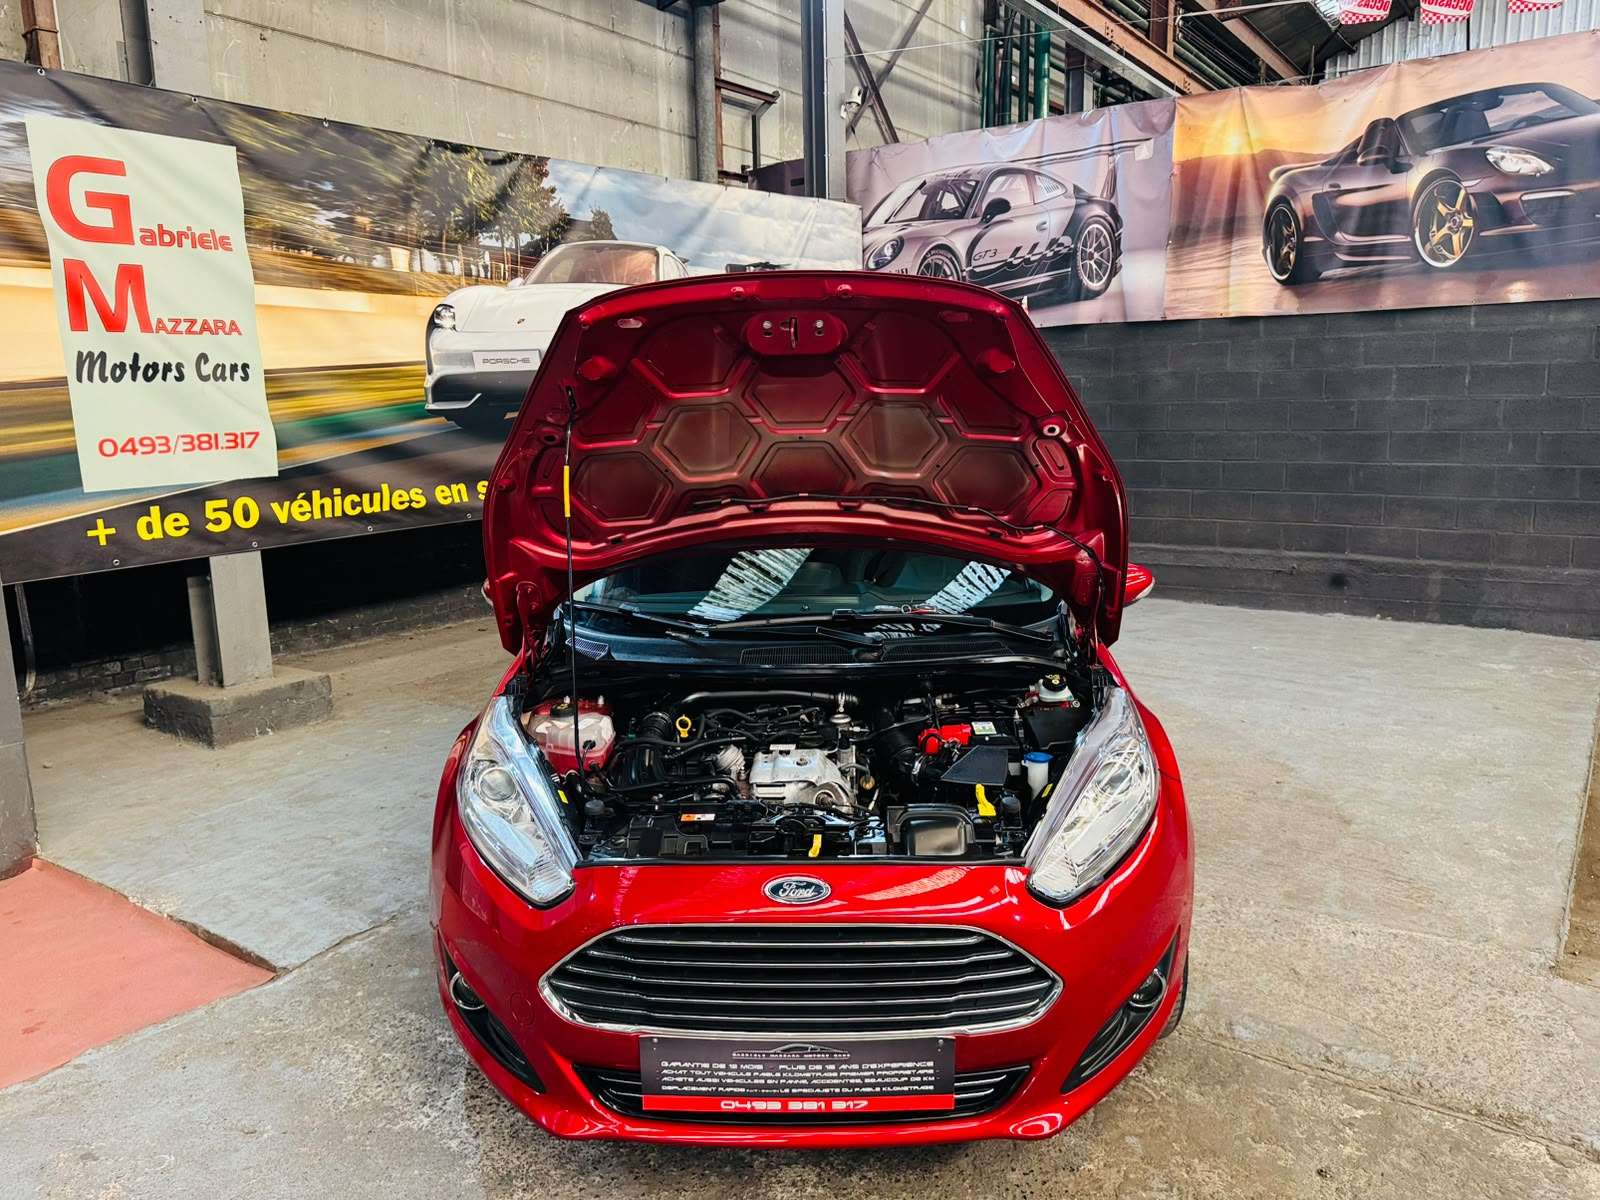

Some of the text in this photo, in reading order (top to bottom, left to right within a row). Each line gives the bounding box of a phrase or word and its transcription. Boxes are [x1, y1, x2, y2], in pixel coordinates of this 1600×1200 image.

[973, 248, 998, 262] GT3
[63, 258, 242, 336] MAZZARA
[75, 350, 250, 384] Motors Cars
[482, 357, 531, 365] PORSCHE
[98, 431, 260, 458] 0493/381.317
[86, 518, 116, 546] +
[136, 505, 190, 541] de
[204, 496, 260, 532] 50
[270, 483, 426, 524] véhicules
[434, 482, 469, 506] en
[779, 881, 818, 897] Ford
[661, 1061, 710, 1069] GARANTIE
[721, 1100, 868, 1110] 0493 381 317
